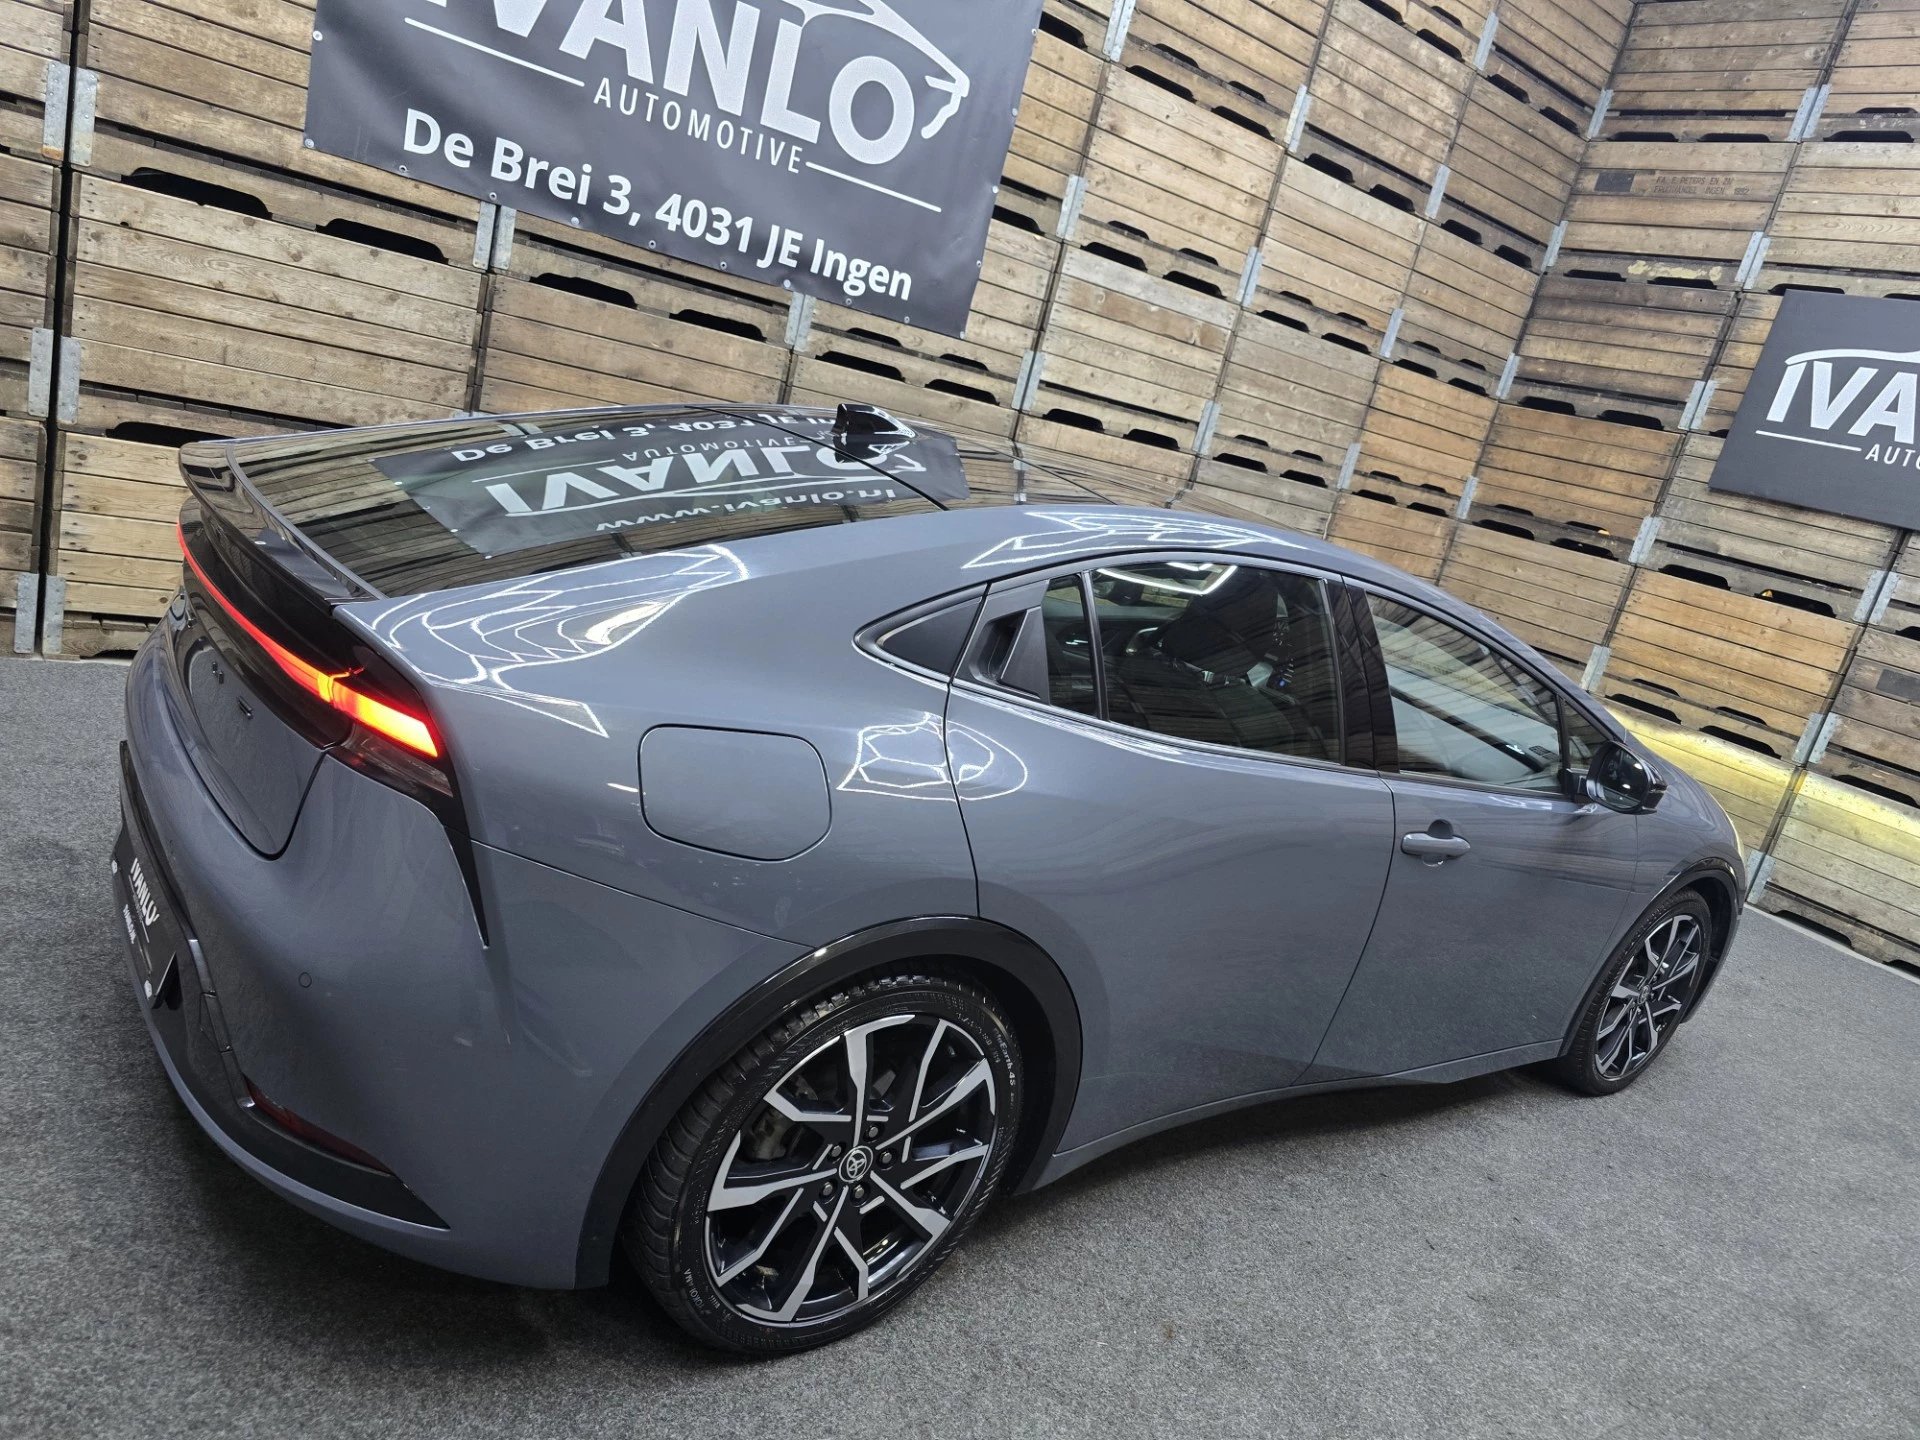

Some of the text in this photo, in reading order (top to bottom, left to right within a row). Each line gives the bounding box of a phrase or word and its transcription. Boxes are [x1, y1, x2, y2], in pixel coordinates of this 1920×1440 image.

[426, 0, 915, 165] ANLO
[593, 77, 803, 174] AUTOMOTIVE
[403, 108, 913, 301] De Brei 3, 4031 JE Ingen
